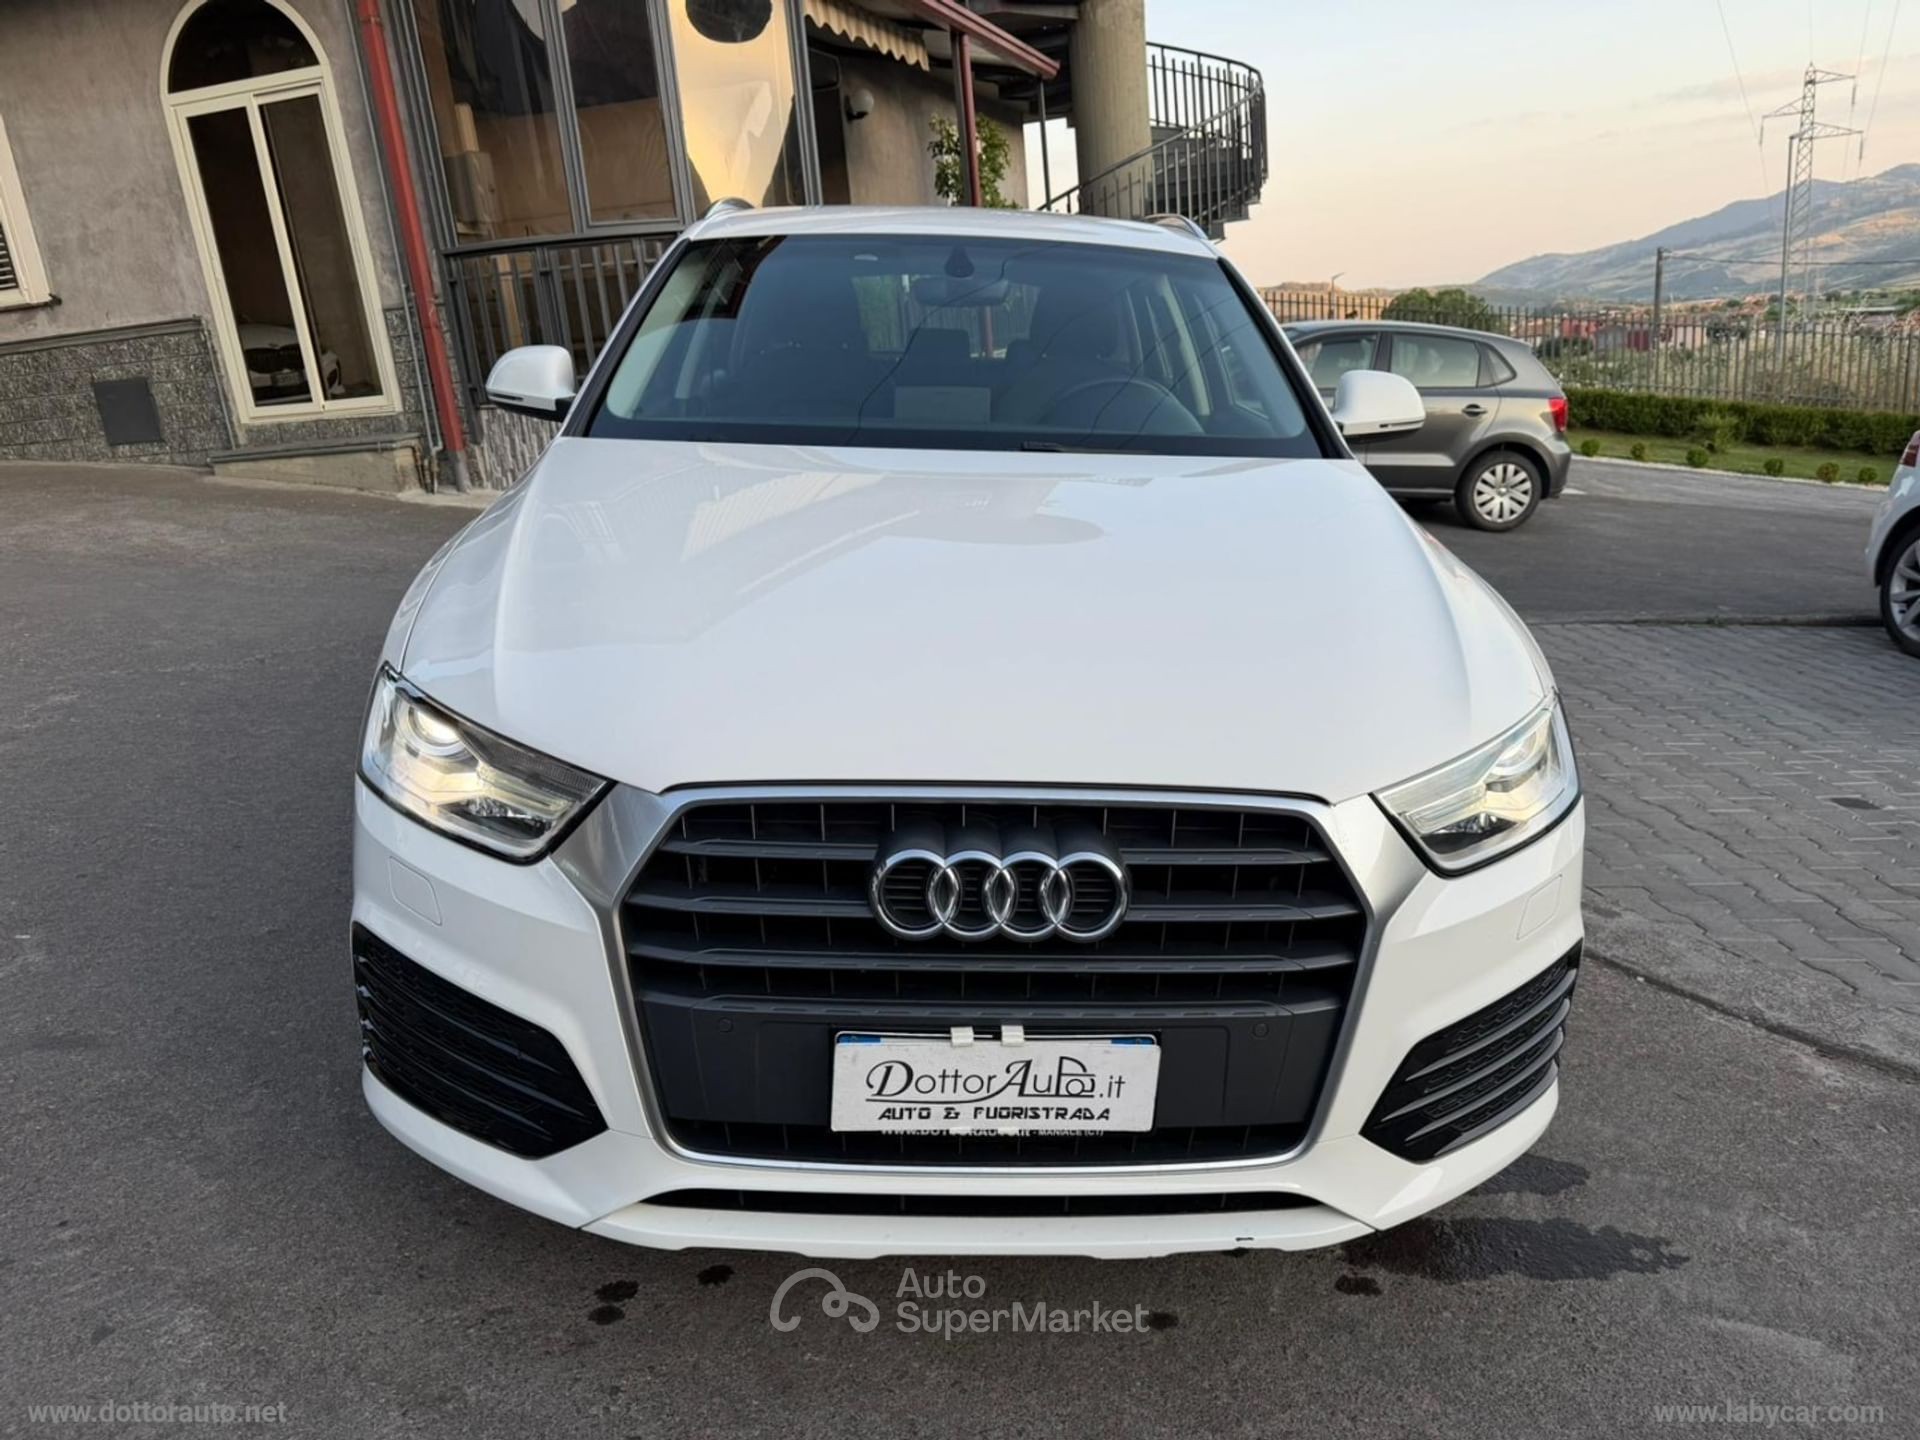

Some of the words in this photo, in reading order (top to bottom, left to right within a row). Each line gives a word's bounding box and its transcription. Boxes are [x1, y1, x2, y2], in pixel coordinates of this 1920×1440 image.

[878, 1106, 931, 1120] AUTO
[943, 1106, 960, 1119] &
[973, 1106, 1110, 1120] FUORISTRADA
